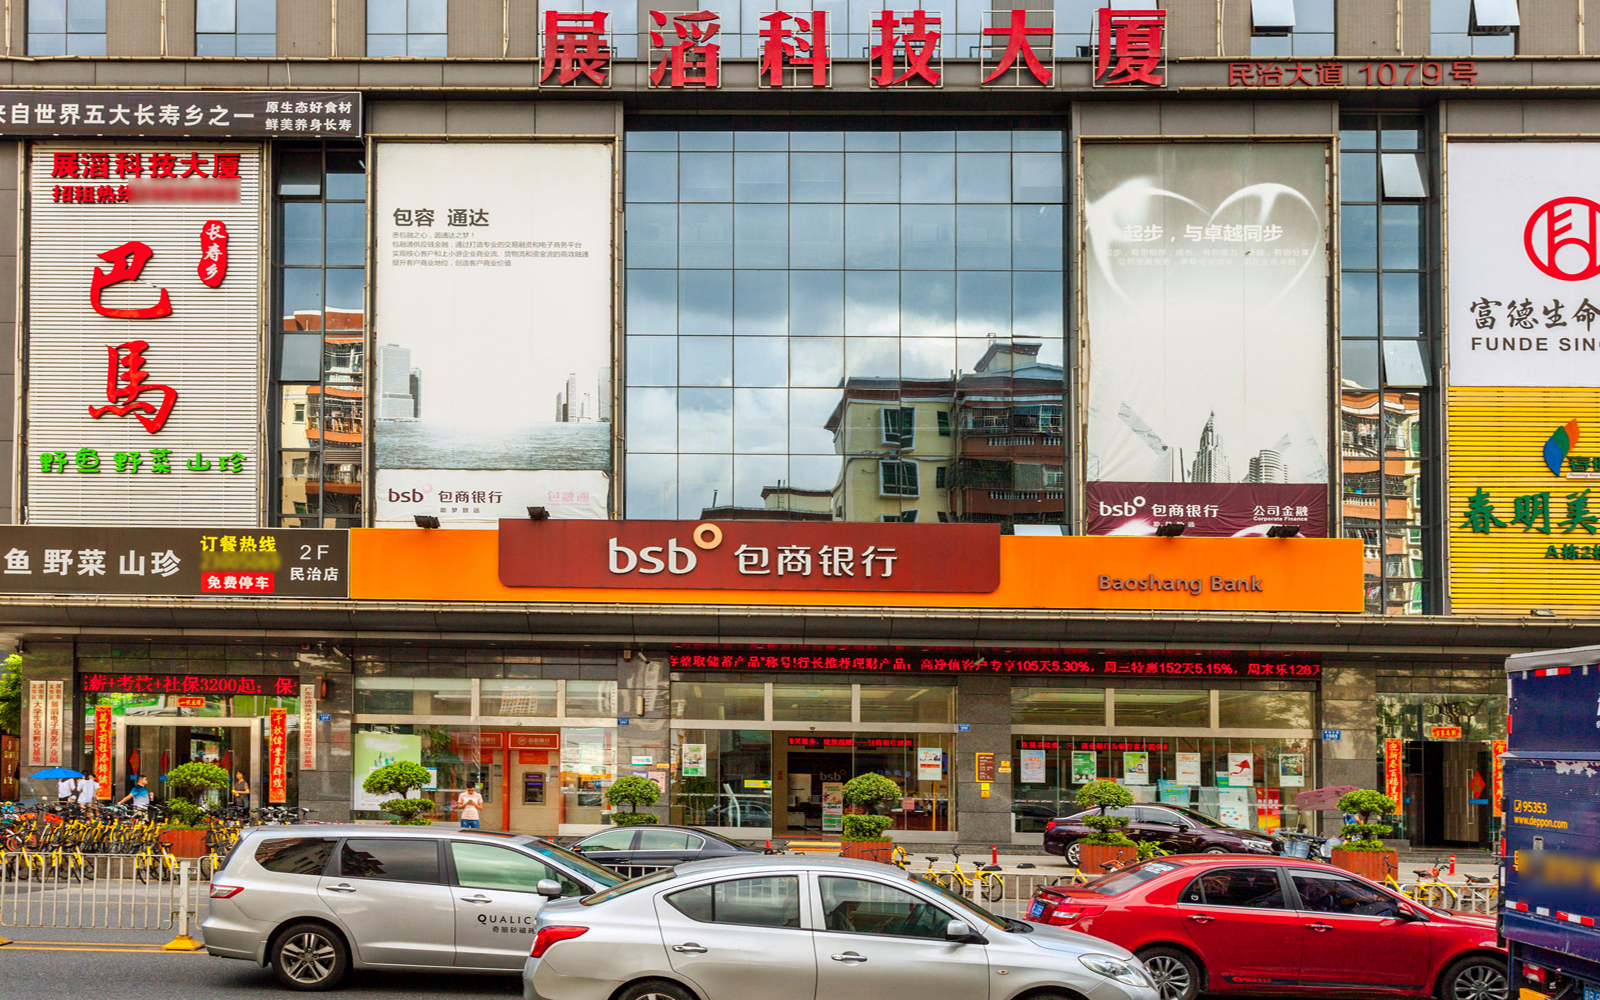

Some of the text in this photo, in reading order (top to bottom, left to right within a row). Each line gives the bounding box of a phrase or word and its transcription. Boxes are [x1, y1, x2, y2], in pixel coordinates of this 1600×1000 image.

[540, 8, 1167, 87] 展滔科技大厦
[1228, 61, 1345, 87] 民治大道
[265, 100, 353, 114] 原生态好食材
[265, 117, 353, 132] 鲜美养身长寿
[51, 151, 242, 179] 展滔科技大厦
[392, 208, 490, 227] 包容 通达
[203, 223, 226, 281] 长寿乡
[1469, 296, 1600, 332] 富德生命
[1471, 337, 1600, 351] FUNDE SIN
[388, 488, 424, 503] bsb
[437, 490, 503, 504] 包商银行
[1099, 501, 1136, 517] bsb
[1151, 504, 1220, 518] 包商银行
[1252, 505, 1309, 517] 公司金融
[1458, 486, 1600, 535] 春明美
[200, 535, 277, 552] 订餐热线
[608, 537, 698, 575] bsb
[733, 544, 898, 578] 包商银行
[289, 567, 339, 582] 民治店
[206, 575, 270, 590] 免费停车
[1098, 574, 1264, 596] Baoshang Bank
[819, 771, 842, 781] bsb
[1522, 800, 1548, 814] 95353
[1513, 815, 1569, 830] www.deppon.com
[477, 913, 537, 926] QUALIC
